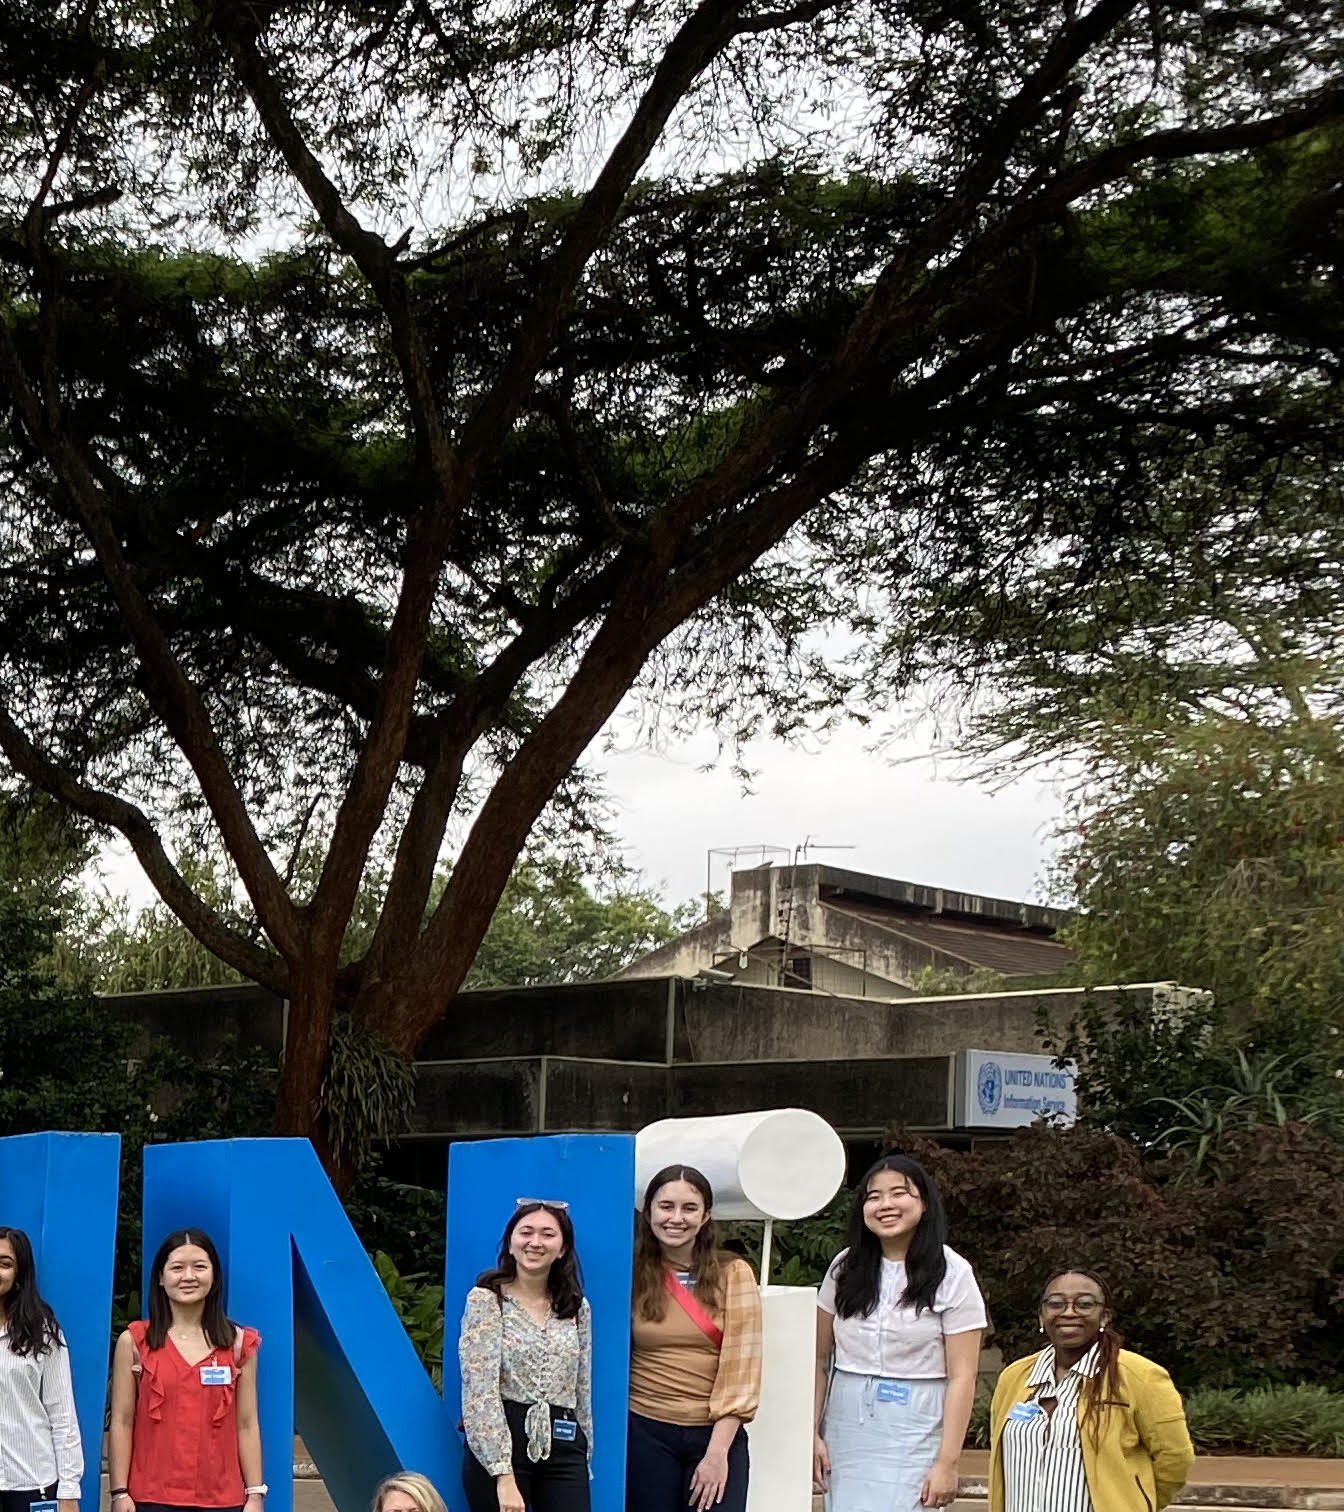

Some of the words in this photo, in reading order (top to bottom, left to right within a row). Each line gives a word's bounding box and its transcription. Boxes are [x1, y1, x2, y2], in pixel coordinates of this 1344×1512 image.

[1005, 1069, 1032, 1087] UNITED
[1034, 1071, 1066, 1089] NATIONS
[1004, 1093, 1041, 1110] Information
[1041, 1096, 1065, 1112] Service
